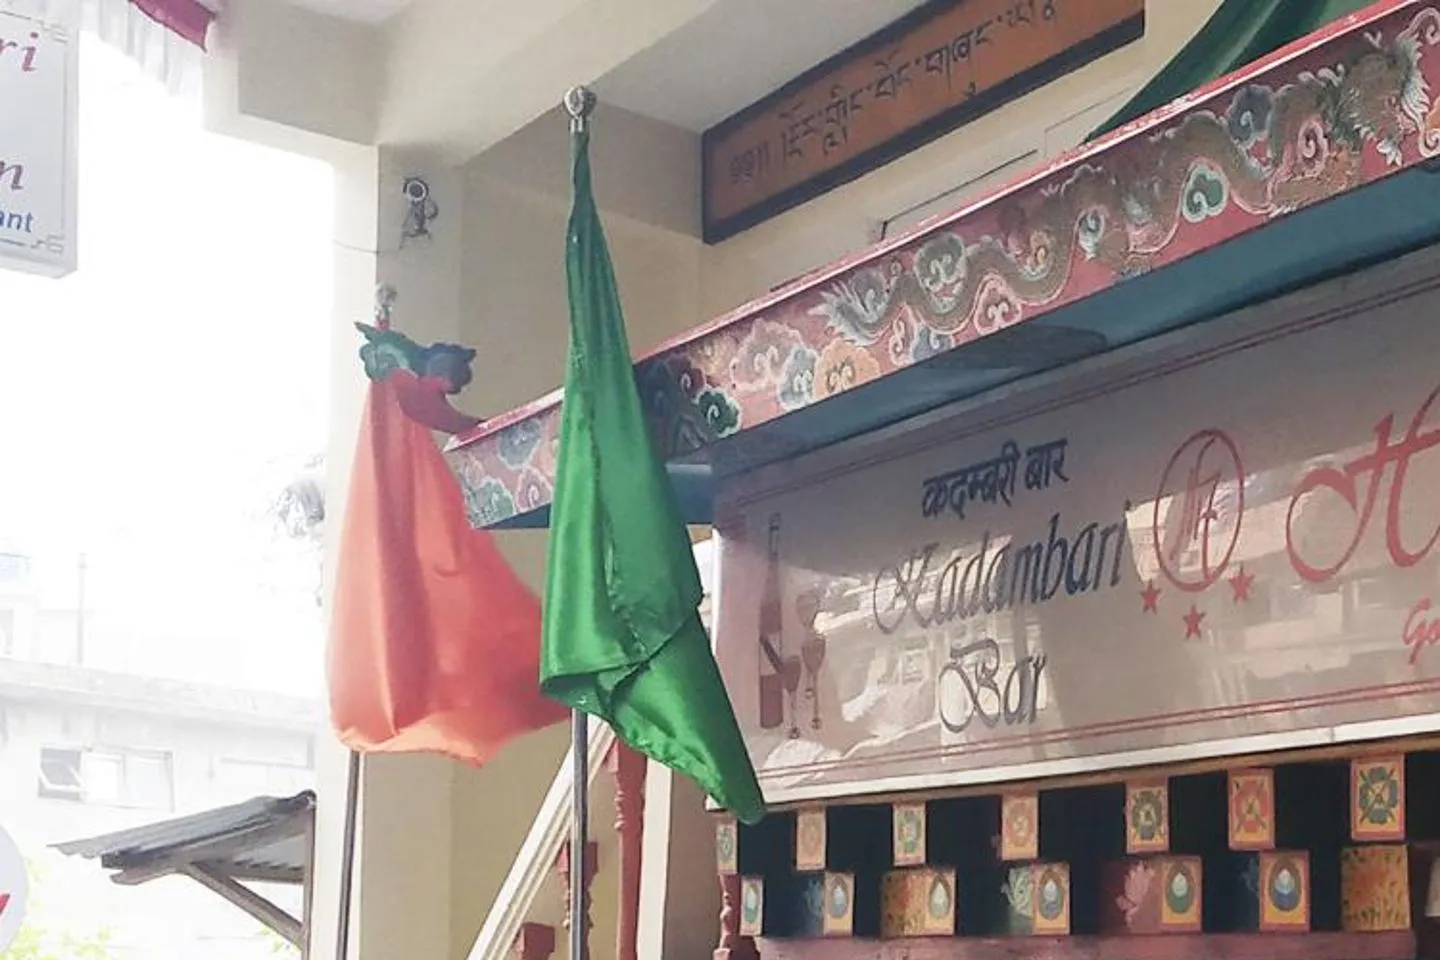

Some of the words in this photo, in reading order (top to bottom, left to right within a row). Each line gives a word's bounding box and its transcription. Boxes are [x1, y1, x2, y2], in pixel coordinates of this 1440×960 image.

[1026, 438, 1069, 490] बार
[873, 499, 1132, 635] Kadambari
[938, 637, 1047, 733] Bar
